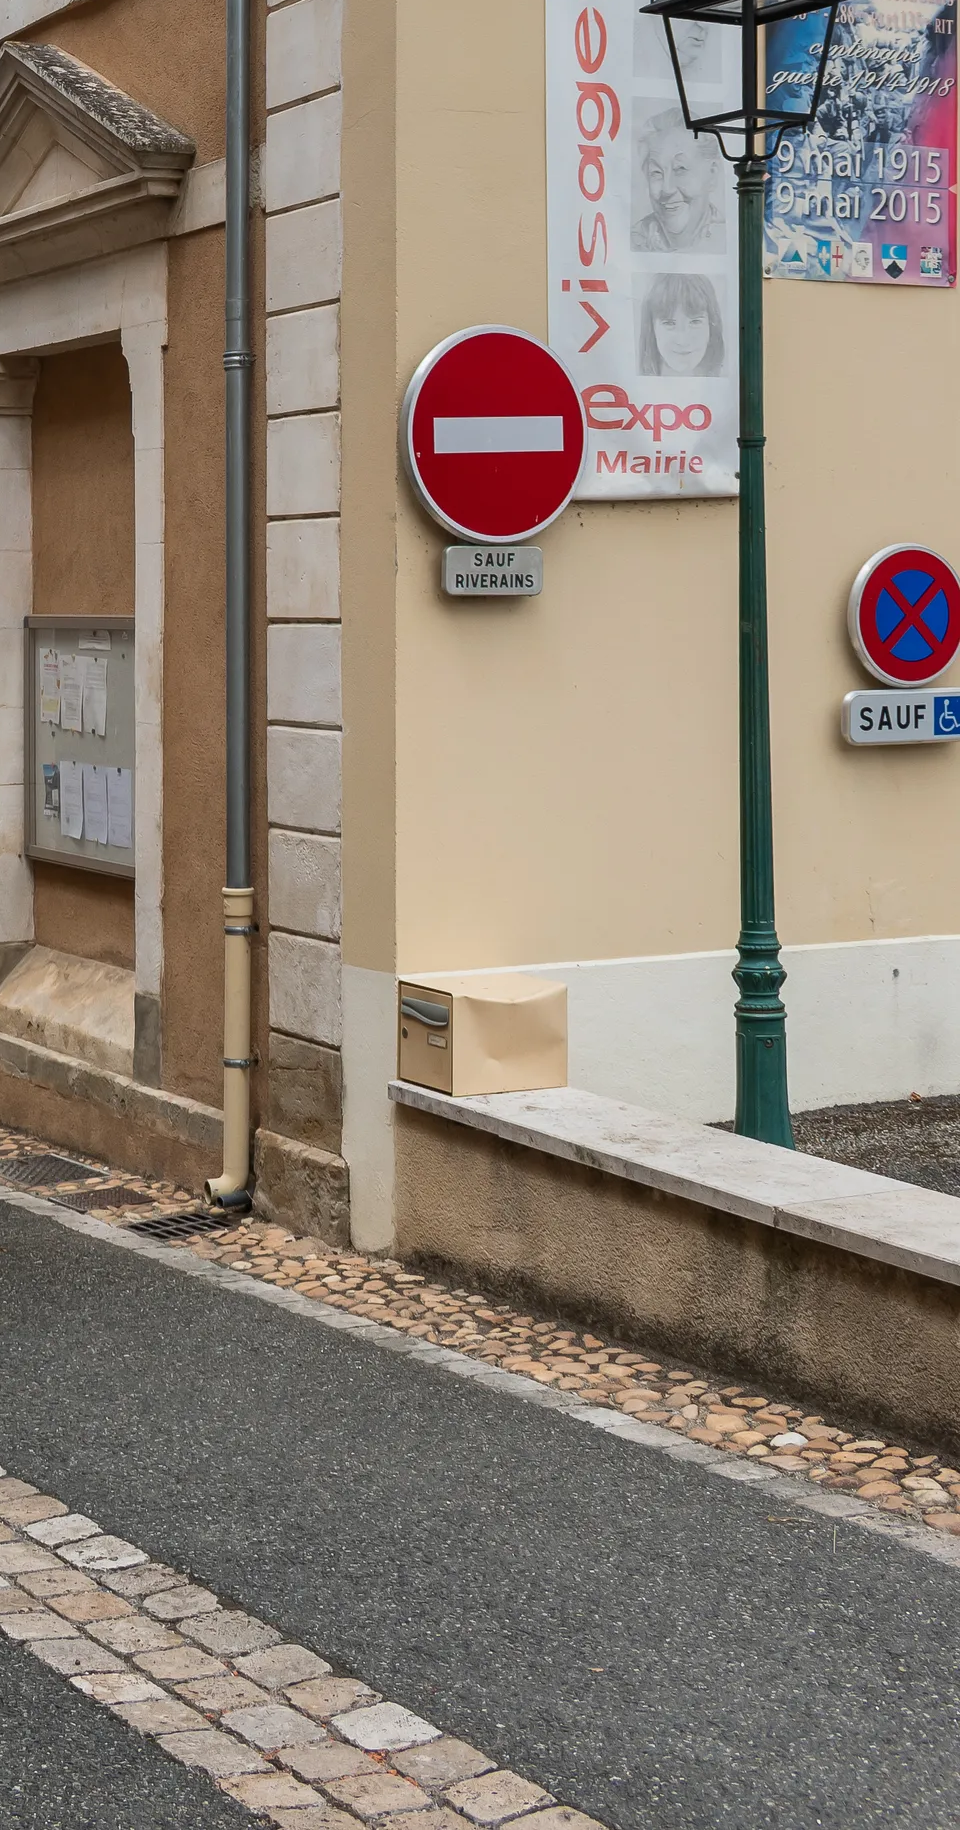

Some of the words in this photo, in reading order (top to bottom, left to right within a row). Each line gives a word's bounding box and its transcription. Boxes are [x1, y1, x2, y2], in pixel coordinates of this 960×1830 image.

[934, 18, 954, 35] RIT
[808, 39, 921, 64] cntenaire
[776, 140, 795, 173] 9
[805, 147, 862, 178] mai
[873, 147, 942, 185] 1915
[776, 181, 795, 214] 9
[805, 185, 860, 219] mai
[869, 188, 942, 224] 2015
[596, 450, 704, 474] Mairie
[473, 552, 516, 567] SAUF
[455, 573, 535, 588] RIVERAINS
[859, 704, 927, 731] SAUF
